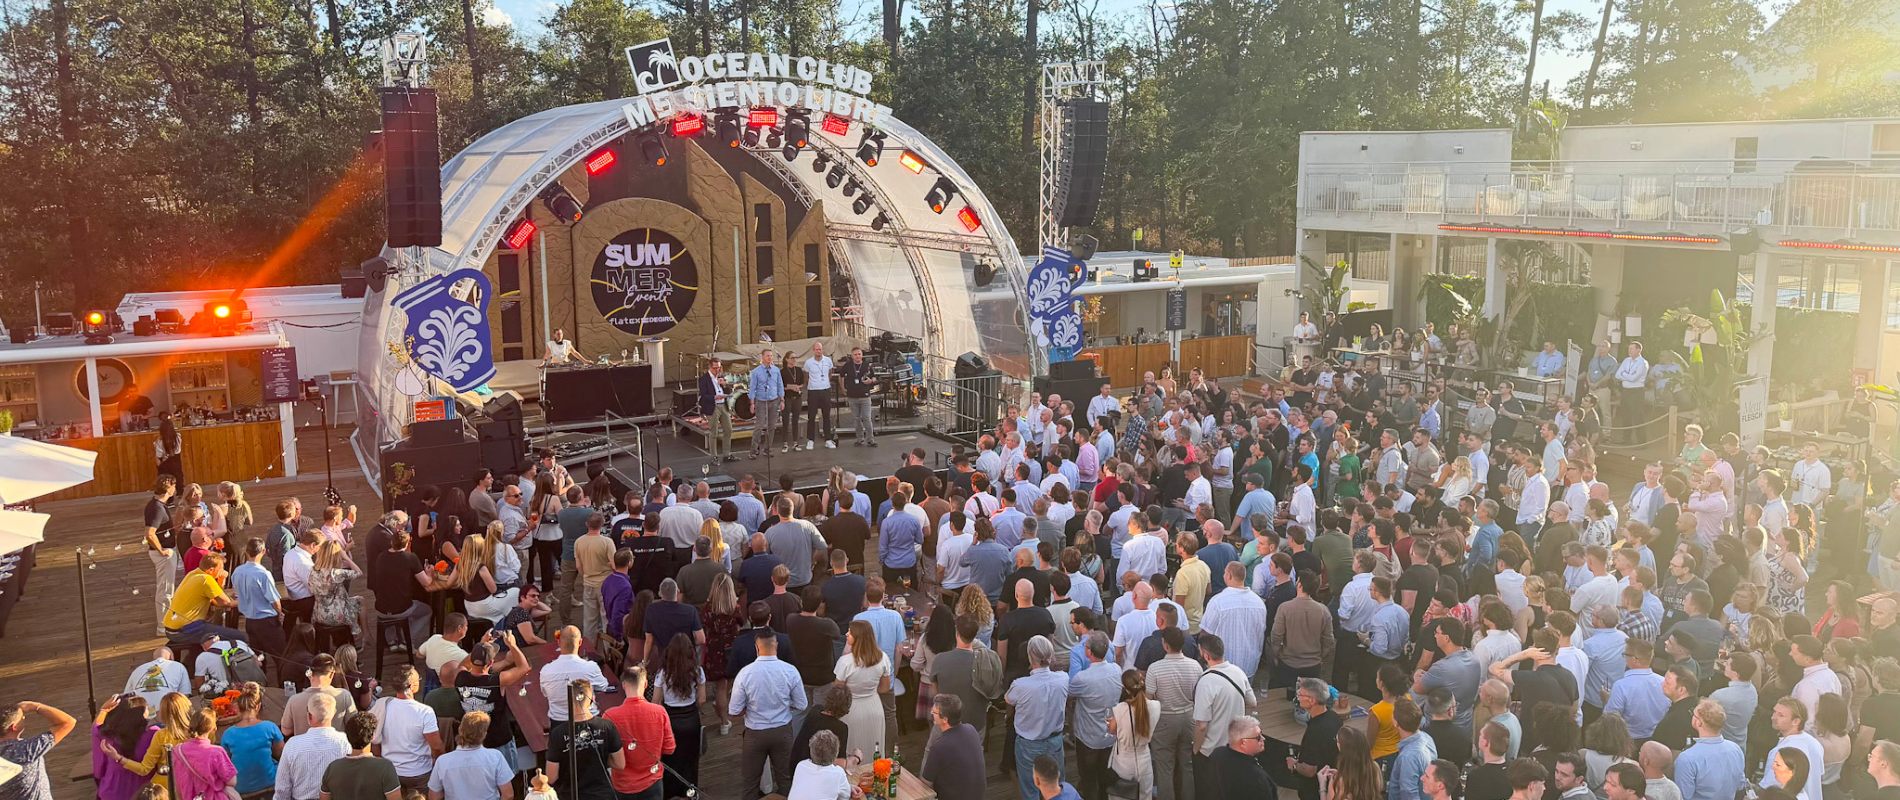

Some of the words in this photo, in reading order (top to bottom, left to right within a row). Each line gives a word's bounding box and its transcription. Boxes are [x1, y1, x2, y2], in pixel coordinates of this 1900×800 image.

[680, 52, 789, 82] OCEAN
[797, 56, 873, 95] CLUB
[622, 90, 674, 130] ME
[683, 81, 799, 109] SIENTO
[804, 86, 893, 129] LIBRE
[605, 243, 671, 267] SUM
[606, 268, 672, 293] MER
[624, 284, 673, 308] Event
[1742, 411, 1763, 422] FLEISCH
